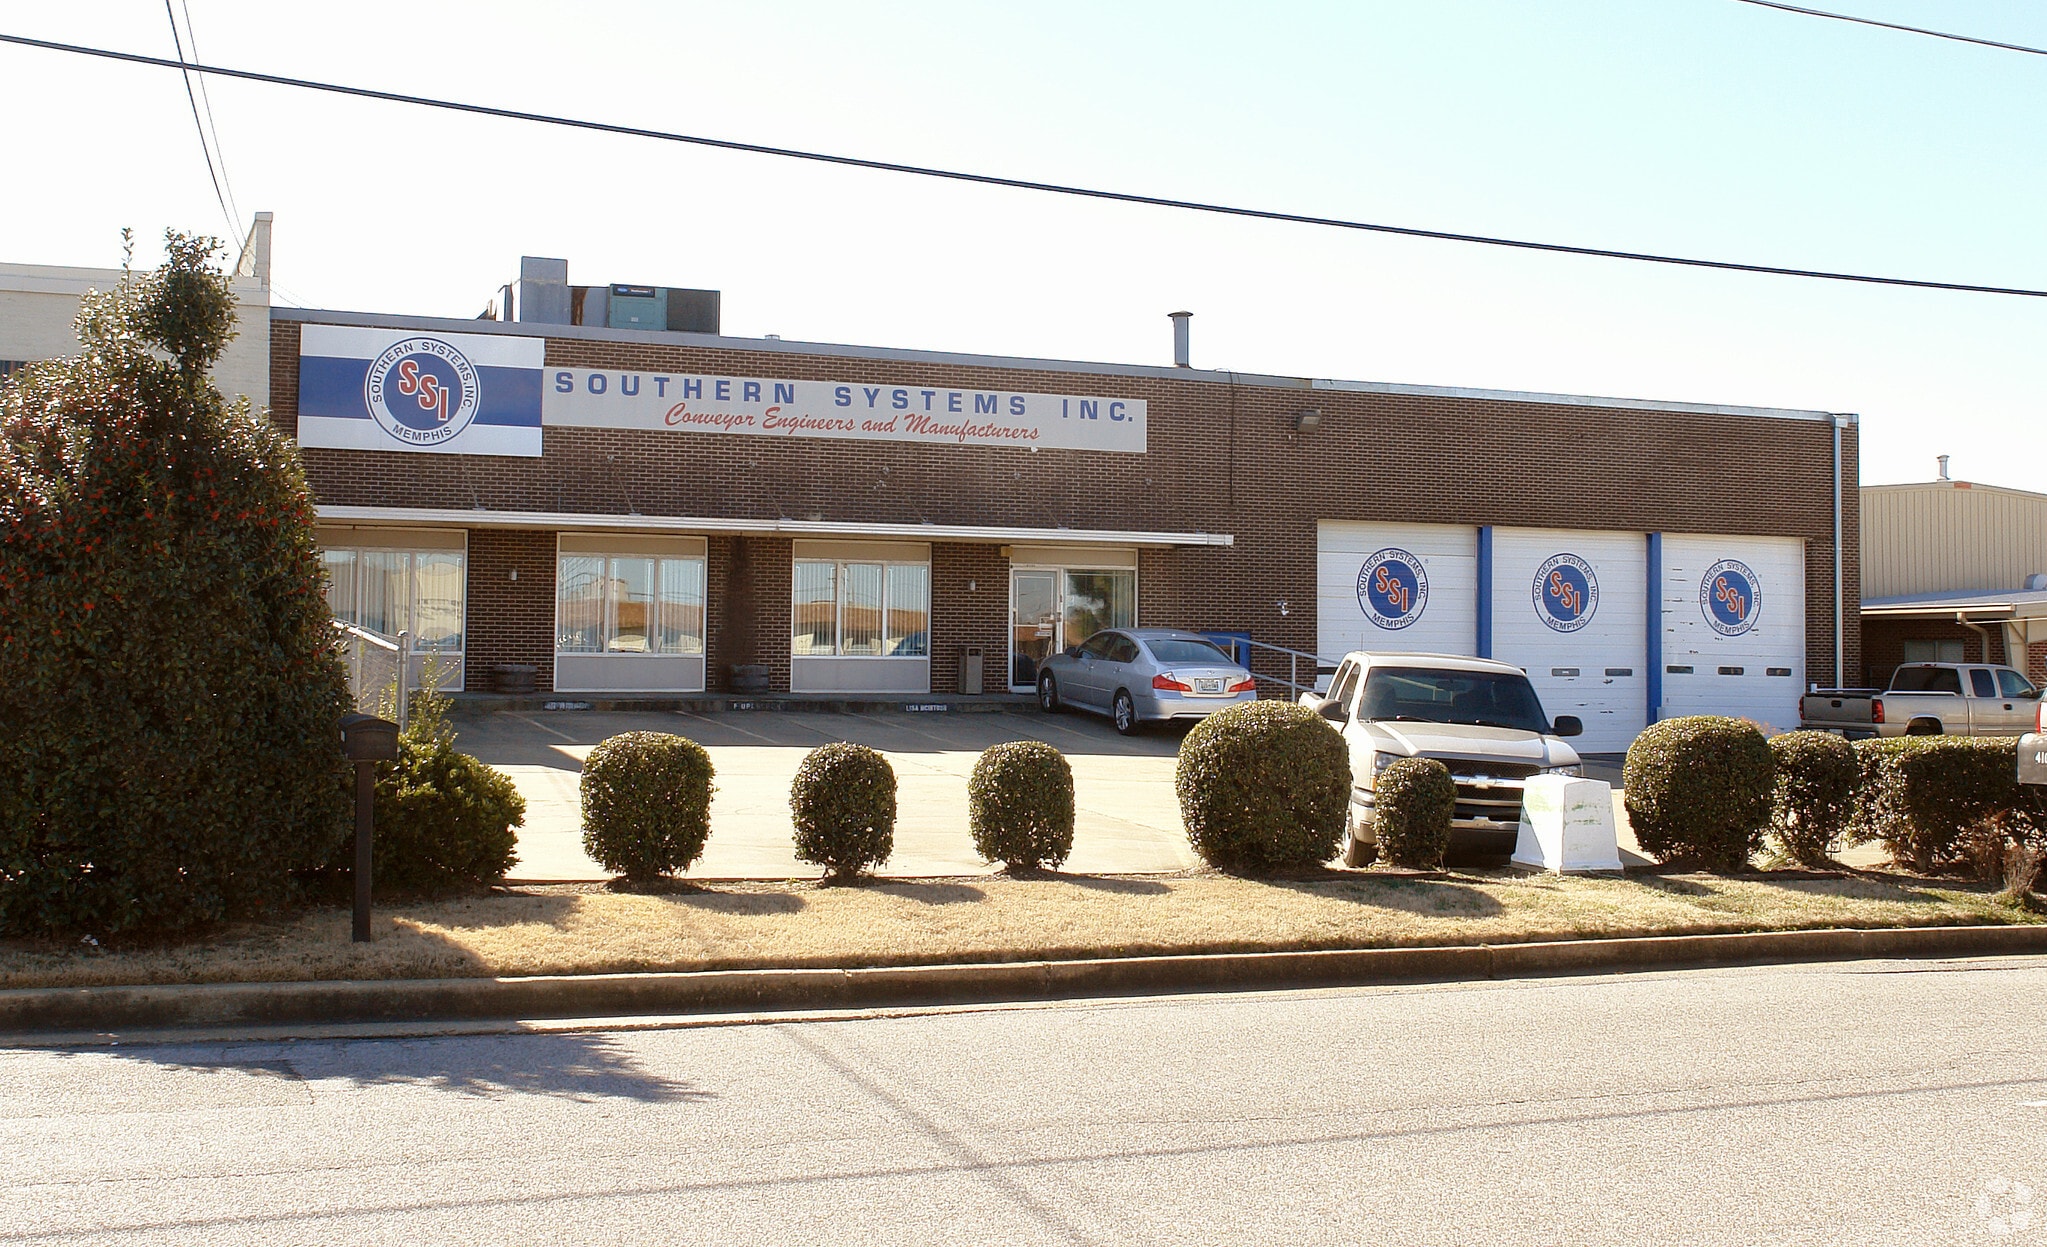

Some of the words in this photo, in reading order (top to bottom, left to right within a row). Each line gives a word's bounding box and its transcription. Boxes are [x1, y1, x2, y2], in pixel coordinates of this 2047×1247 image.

[371, 342, 414, 403] SOUTHERN
[399, 360, 449, 421] SSI
[555, 371, 794, 404] SOUTHERN
[834, 386, 1026, 415] SYSTEMS
[1062, 398, 1133, 422] INC.
[392, 425, 452, 442] MEMPHIS
[664, 402, 756, 431] Conveyor
[762, 406, 856, 435] Engineers
[861, 415, 898, 433] and
[903, 413, 1040, 443] Manufacturers
[1359, 552, 1386, 597] SOUTHERN
[1376, 566, 1408, 612] SSI
[1534, 558, 1559, 601] SOUTHERN
[1550, 571, 1580, 615] SSI
[1716, 577, 1745, 620] SSI
[1372, 613, 1415, 628] MEMPHIS
[1547, 616, 1586, 630] MEMPHIS
[1713, 620, 1750, 634] MEMPHIS
